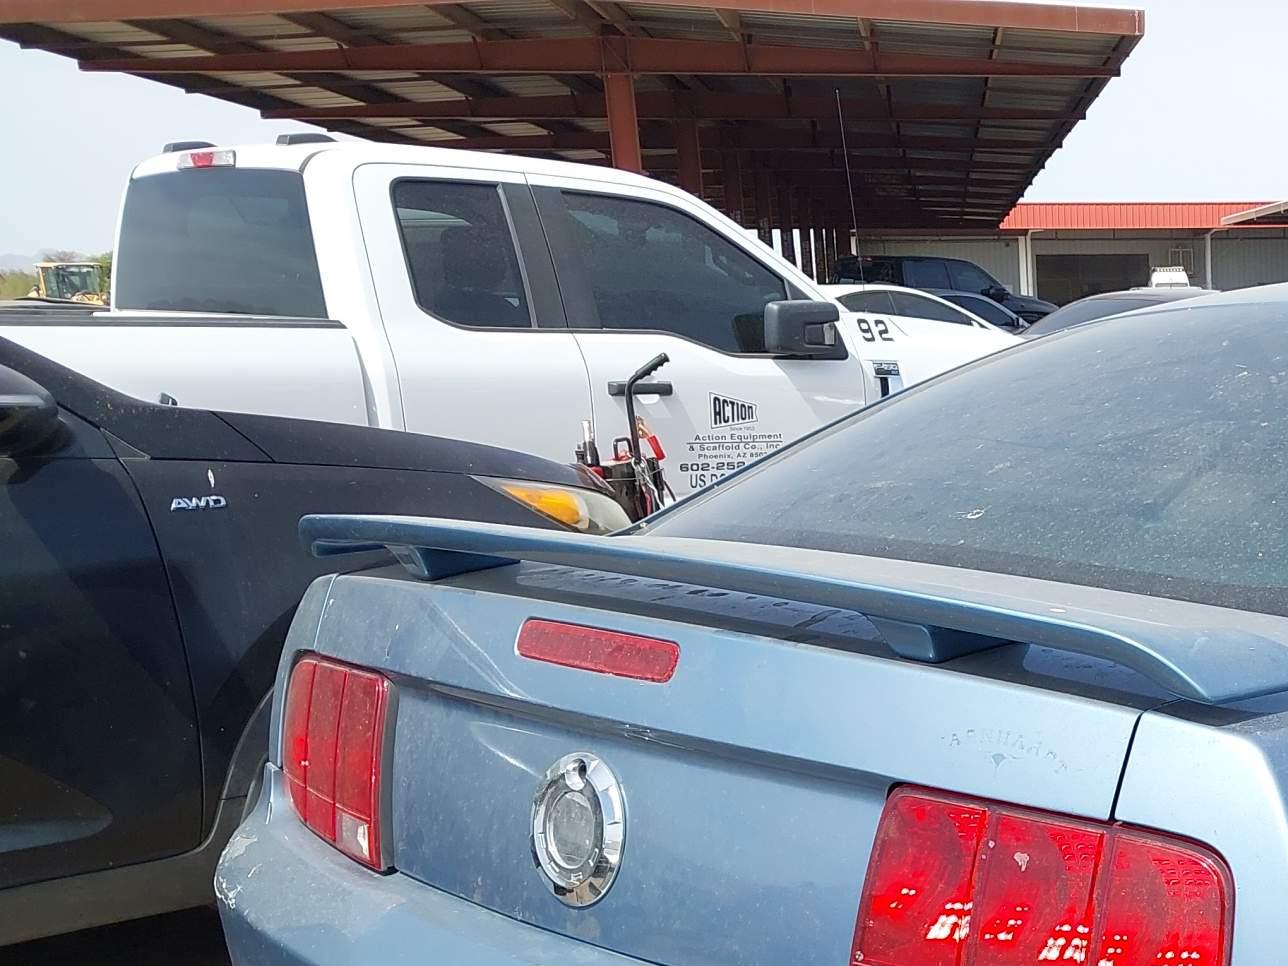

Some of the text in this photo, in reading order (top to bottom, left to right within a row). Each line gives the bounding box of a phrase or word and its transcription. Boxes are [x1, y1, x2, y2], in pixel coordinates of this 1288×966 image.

[857, 318, 895, 342] 92
[694, 433, 782, 443] Action Equipment
[699, 443, 740, 452] Scaffold
[689, 474, 706, 489] US
[170, 495, 227, 512] AWD
